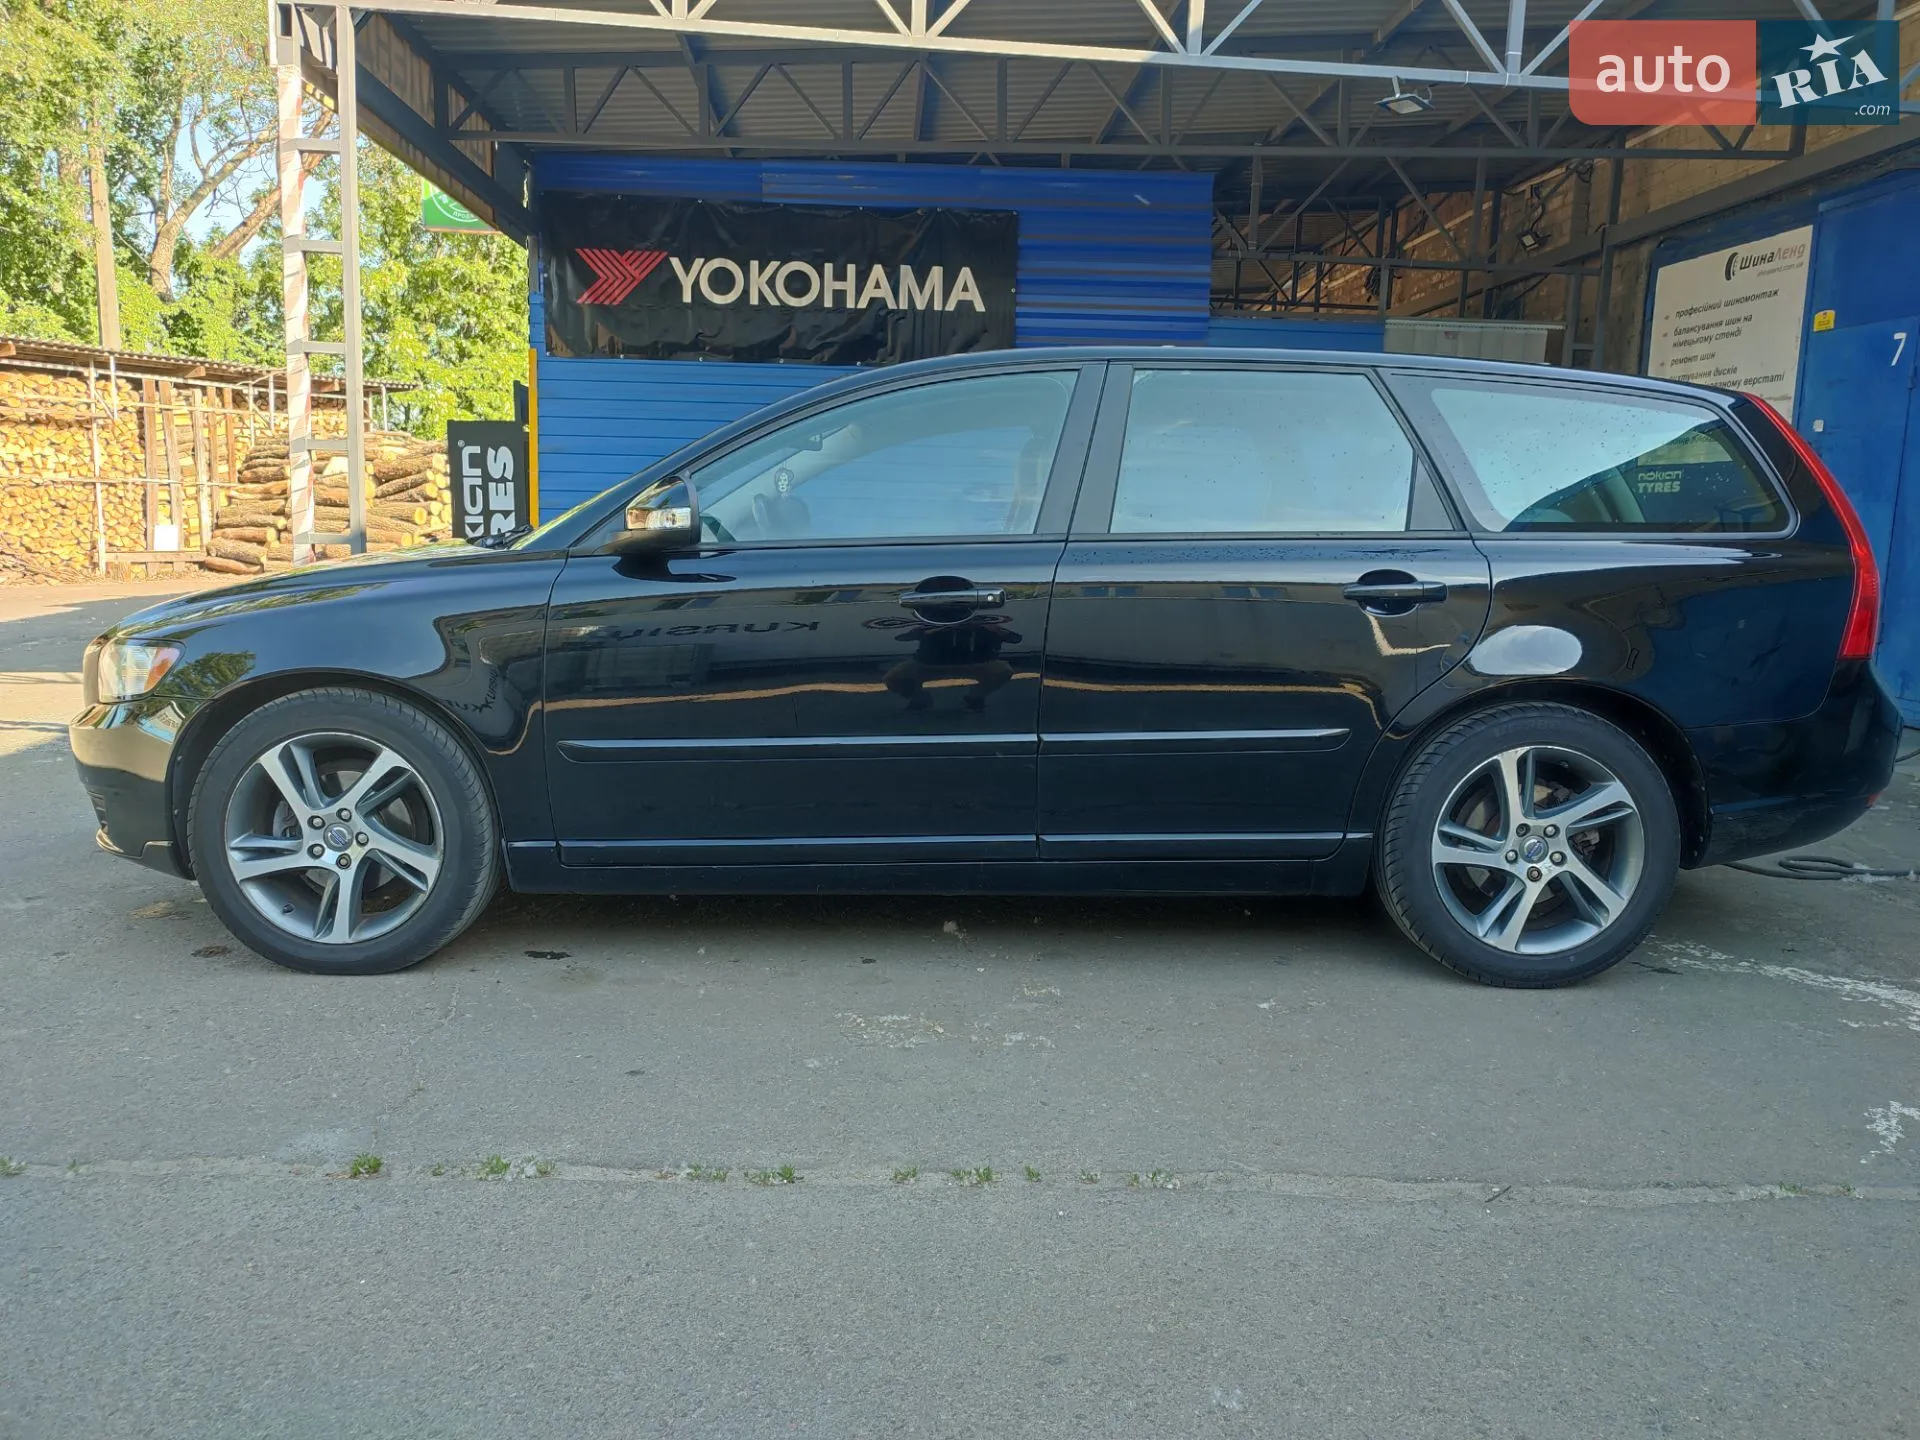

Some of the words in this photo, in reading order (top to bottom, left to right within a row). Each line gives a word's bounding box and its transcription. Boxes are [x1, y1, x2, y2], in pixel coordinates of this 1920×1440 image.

[669, 256, 986, 313] YOKOHAMA
[1674, 301, 1722, 320] професійний
[1723, 288, 1780, 309] шиномонтаж
[1673, 319, 1724, 337] балансування
[1725, 316, 1742, 327] шин
[1743, 314, 1753, 323] на
[1669, 354, 1699, 367] ремонт
[1700, 351, 1716, 361] шин
[1891, 332, 1907, 367] 7
[1713, 365, 1738, 377] дисків
[1743, 370, 1786, 388] верстаті
[487, 445, 516, 538] RES
[1638, 481, 1681, 493] TYRES
